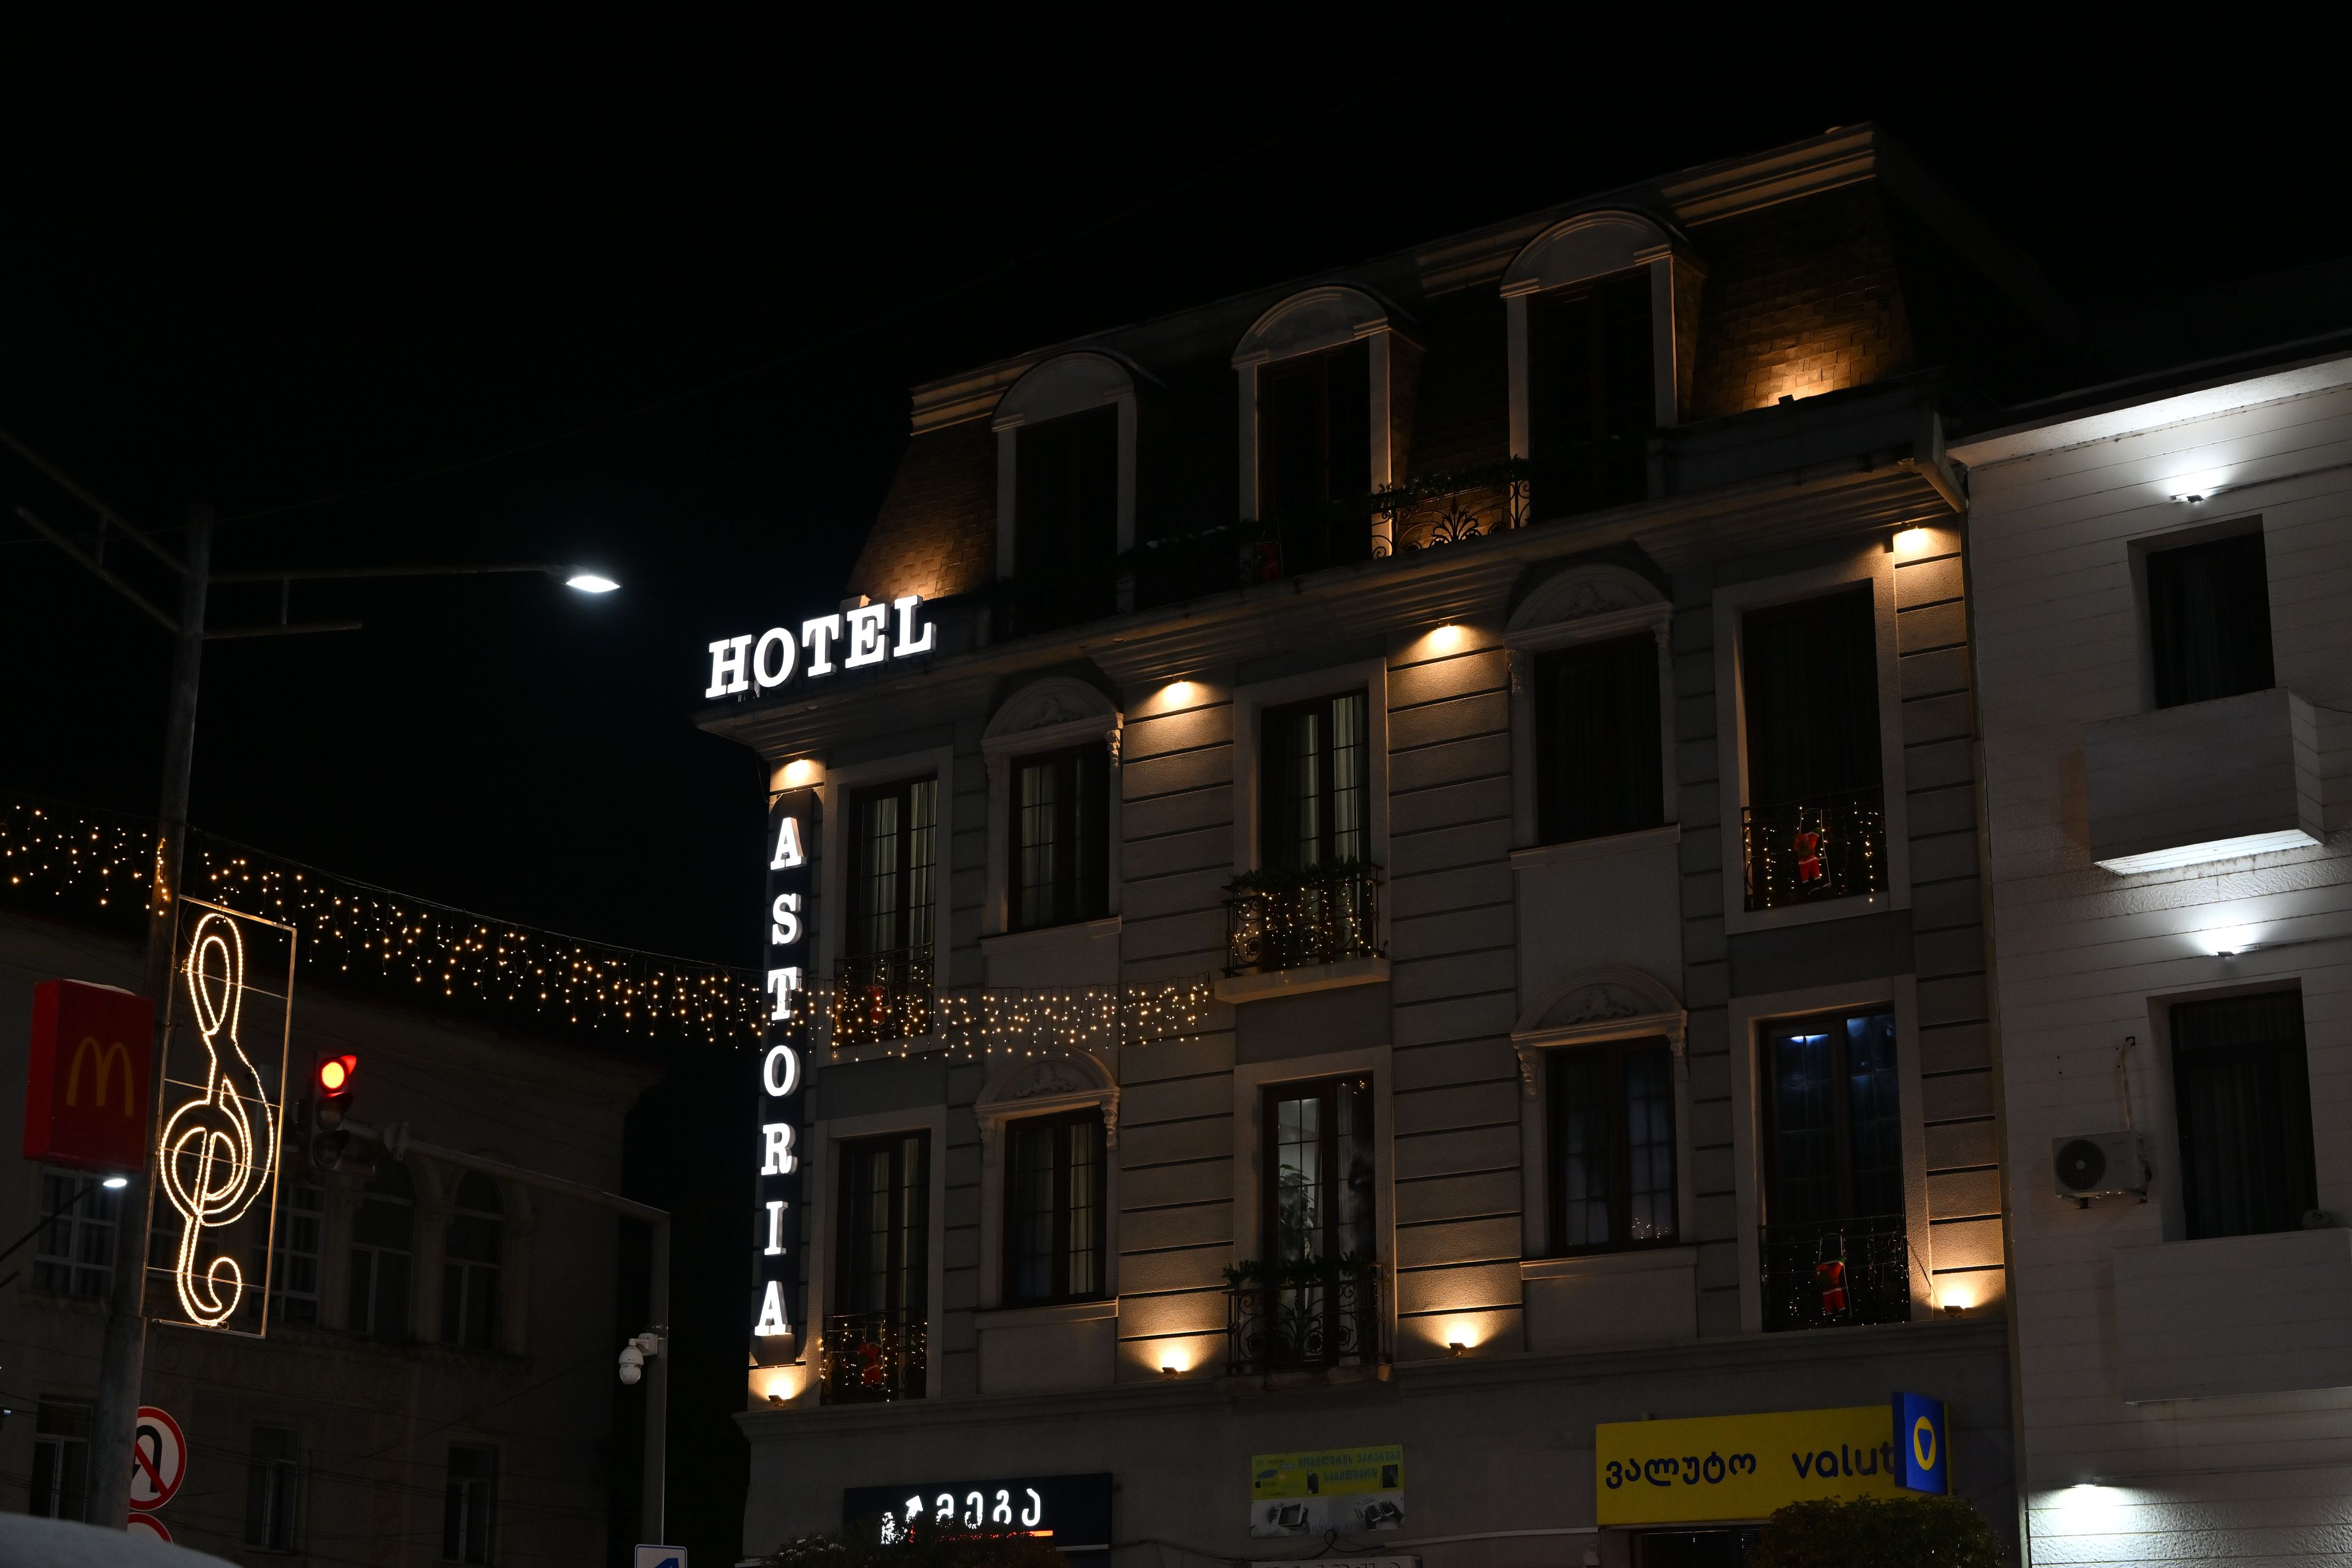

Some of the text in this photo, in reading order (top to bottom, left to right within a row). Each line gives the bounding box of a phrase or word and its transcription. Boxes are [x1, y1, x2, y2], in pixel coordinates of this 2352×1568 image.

[705, 595, 937, 699] HOTEL
[755, 817, 807, 1337] ASTORIA
[1605, 1450, 1757, 1490] ვალუტო
[1791, 1440, 1895, 1480] valut
